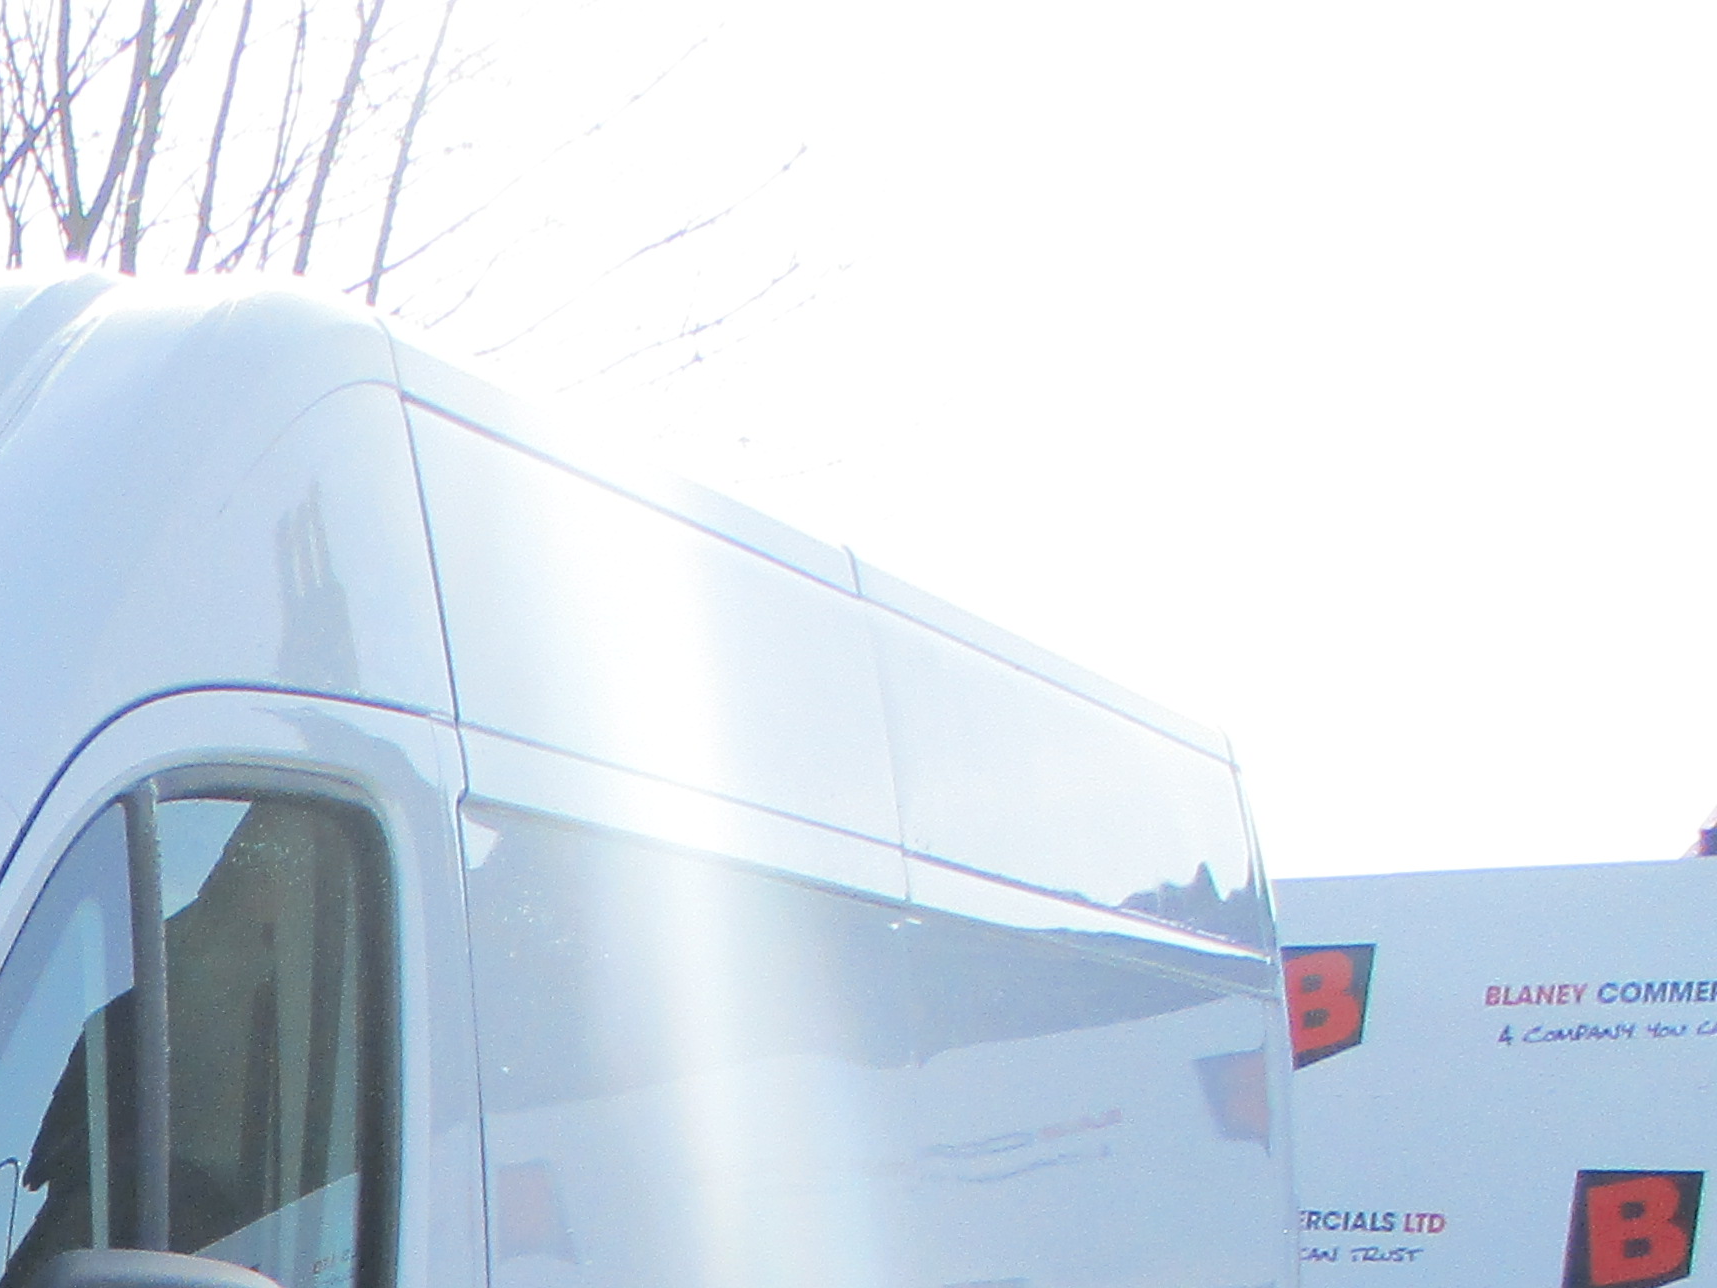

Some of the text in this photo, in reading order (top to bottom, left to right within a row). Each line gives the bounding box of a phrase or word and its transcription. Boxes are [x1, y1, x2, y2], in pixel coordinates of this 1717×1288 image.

[1485, 984, 1588, 1006] BLANEY
[1522, 1022, 1635, 1043] COMPANY
[1647, 1021, 1687, 1038] YOU
[1403, 1212, 1446, 1233] LTD
[1586, 1175, 1688, 1287] B
[1351, 1246, 1424, 1262] TRUST
